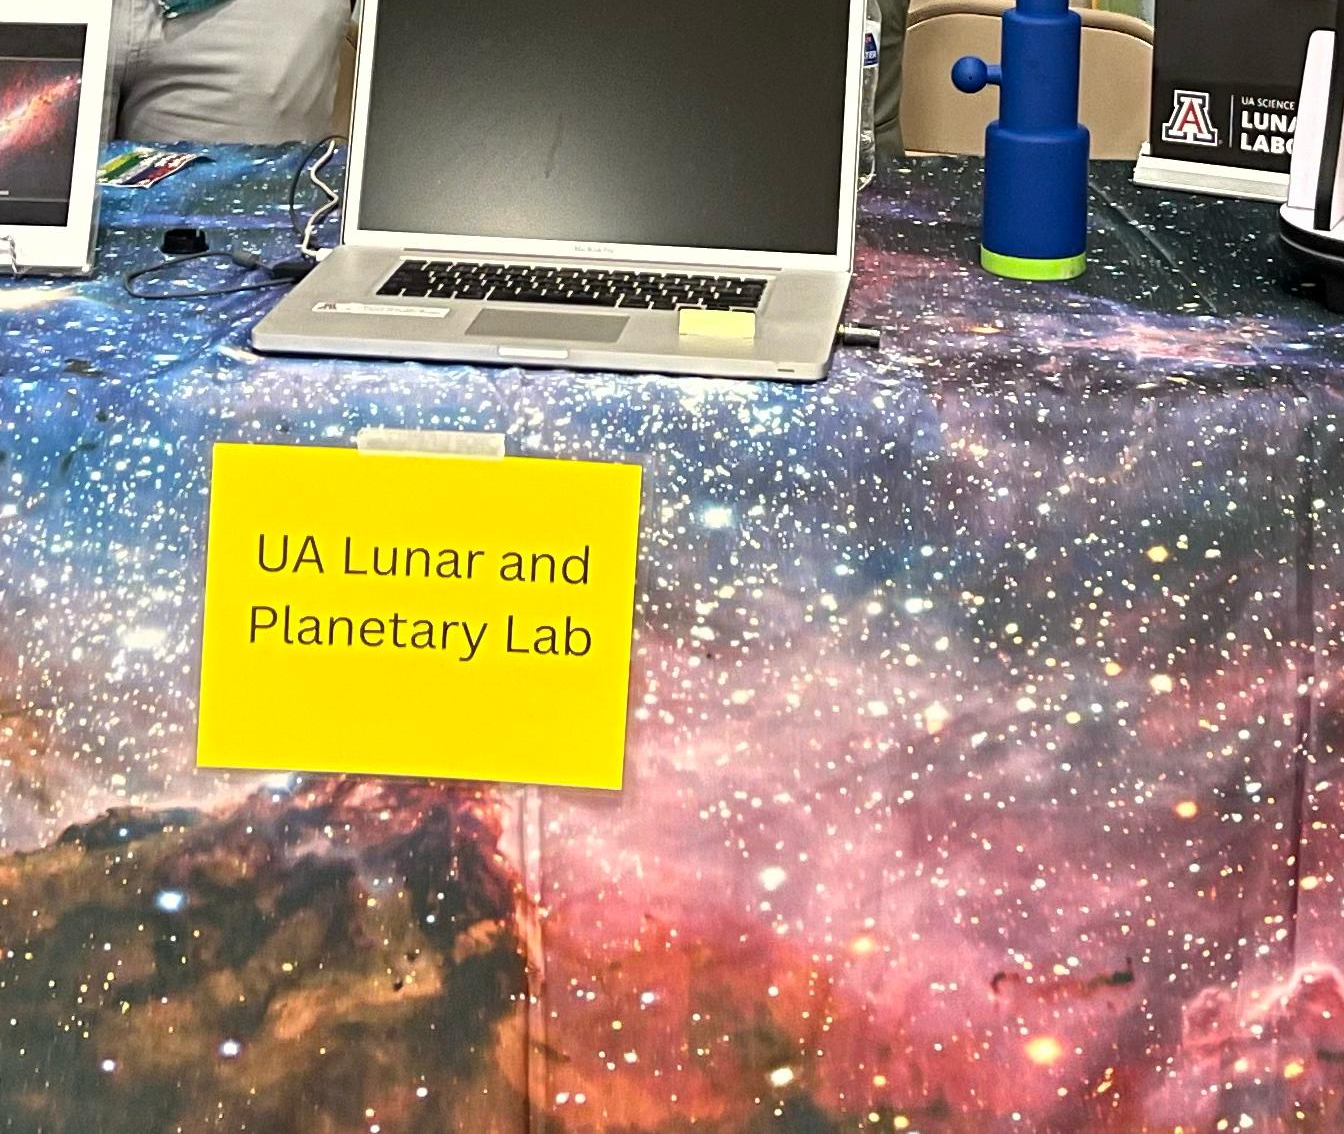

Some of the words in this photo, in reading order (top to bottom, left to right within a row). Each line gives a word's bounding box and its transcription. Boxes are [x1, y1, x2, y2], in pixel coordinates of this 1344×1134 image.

[1241, 96, 1256, 106] UA
[1257, 98, 1296, 110] SCIENCE
[1241, 110, 1297, 133] LUN
[258, 534, 324, 574] UA
[345, 537, 485, 579] Lunar
[500, 546, 590, 585] and
[250, 604, 488, 662] Planetary
[506, 615, 592, 656] Lab
